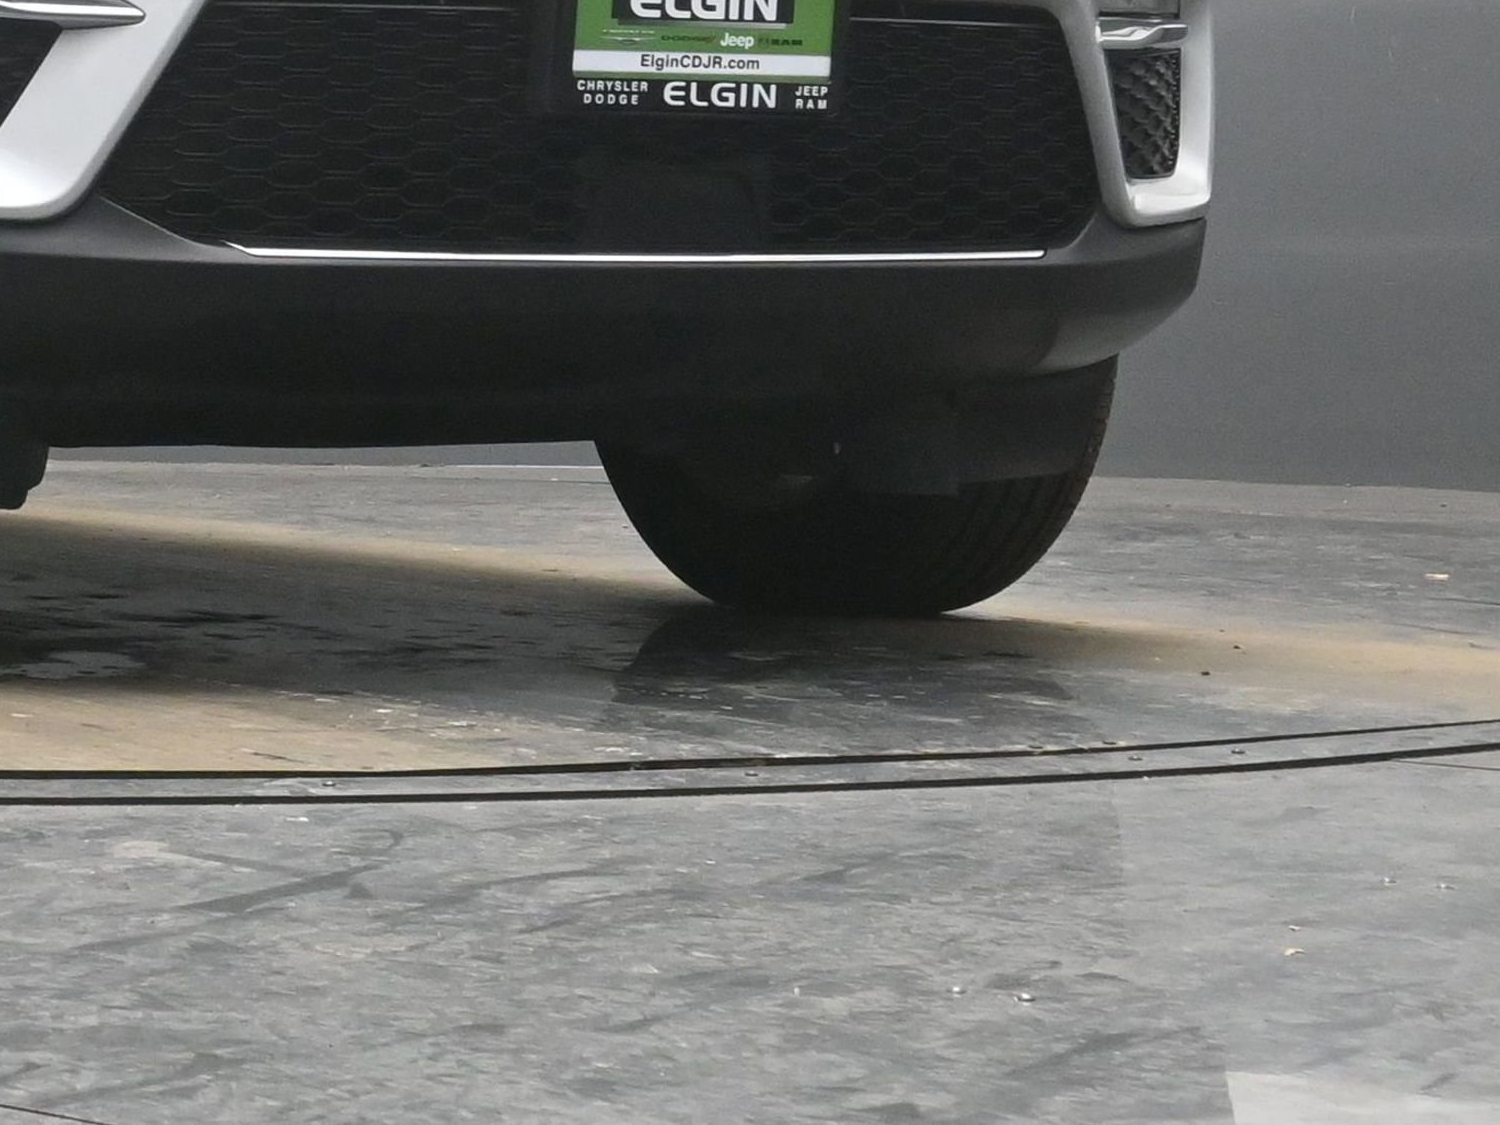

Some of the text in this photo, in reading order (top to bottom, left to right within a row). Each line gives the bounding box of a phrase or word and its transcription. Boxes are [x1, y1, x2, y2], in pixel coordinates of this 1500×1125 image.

[719, 32, 755, 49] Jeep
[640, 54, 760, 71] ElginCDJR.com
[576, 80, 649, 93] CHRYSLER
[794, 86, 829, 98] JEEP
[583, 93, 639, 106] DODGE
[663, 81, 778, 109] ELGIN
[795, 100, 828, 111] RAM
